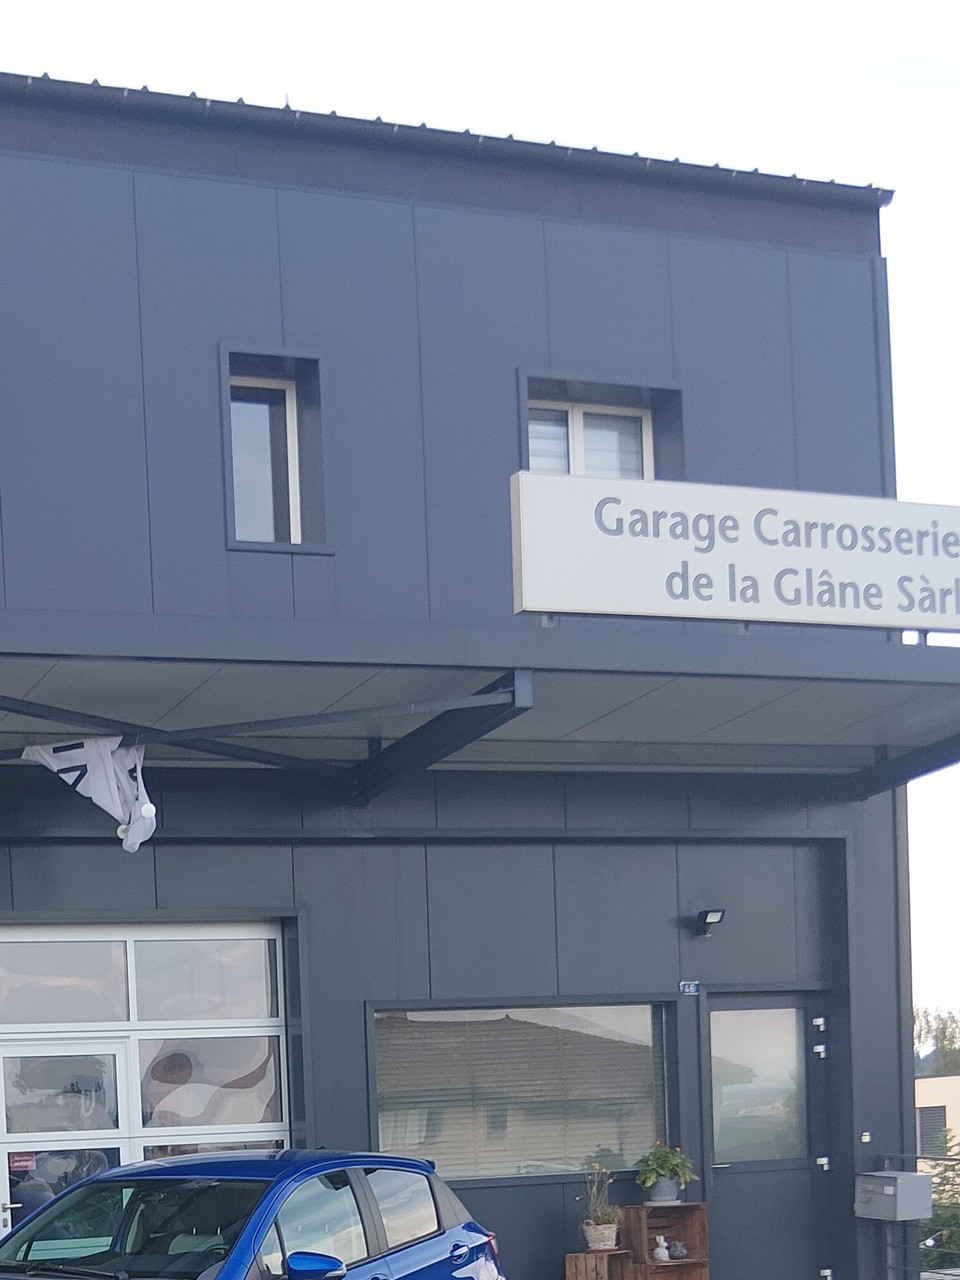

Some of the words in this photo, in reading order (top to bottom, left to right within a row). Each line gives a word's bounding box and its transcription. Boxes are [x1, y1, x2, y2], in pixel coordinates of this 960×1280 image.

[593, 496, 740, 554] Garage
[752, 507, 960, 560] Carrosserie
[664, 560, 715, 602] de
[728, 563, 760, 604] la
[772, 567, 884, 612] Glâne
[896, 573, 960, 615] Sàrl
